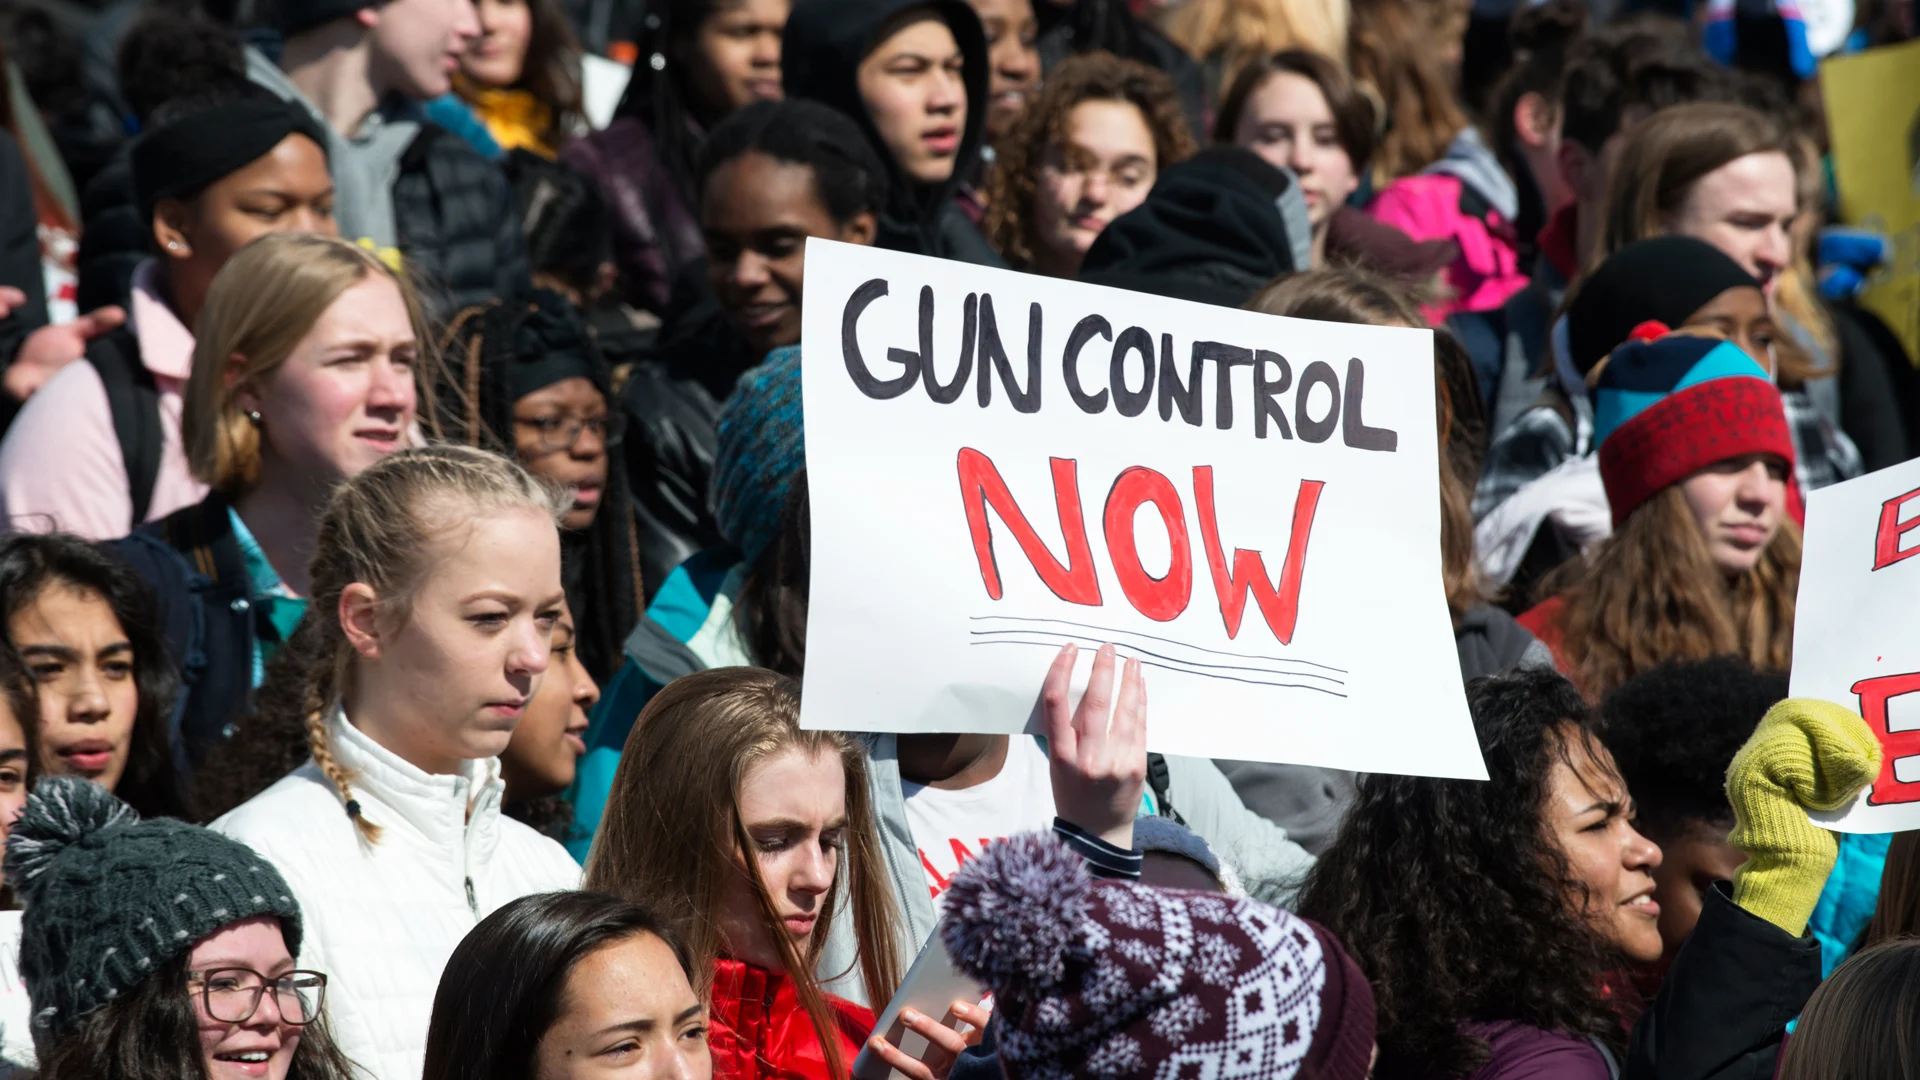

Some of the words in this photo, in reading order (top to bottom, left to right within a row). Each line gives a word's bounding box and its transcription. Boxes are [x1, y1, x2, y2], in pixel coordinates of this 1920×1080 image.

[842, 278, 1042, 413] GUN
[1063, 314, 1398, 452] CONTROL
[957, 447, 1326, 645] NOW
